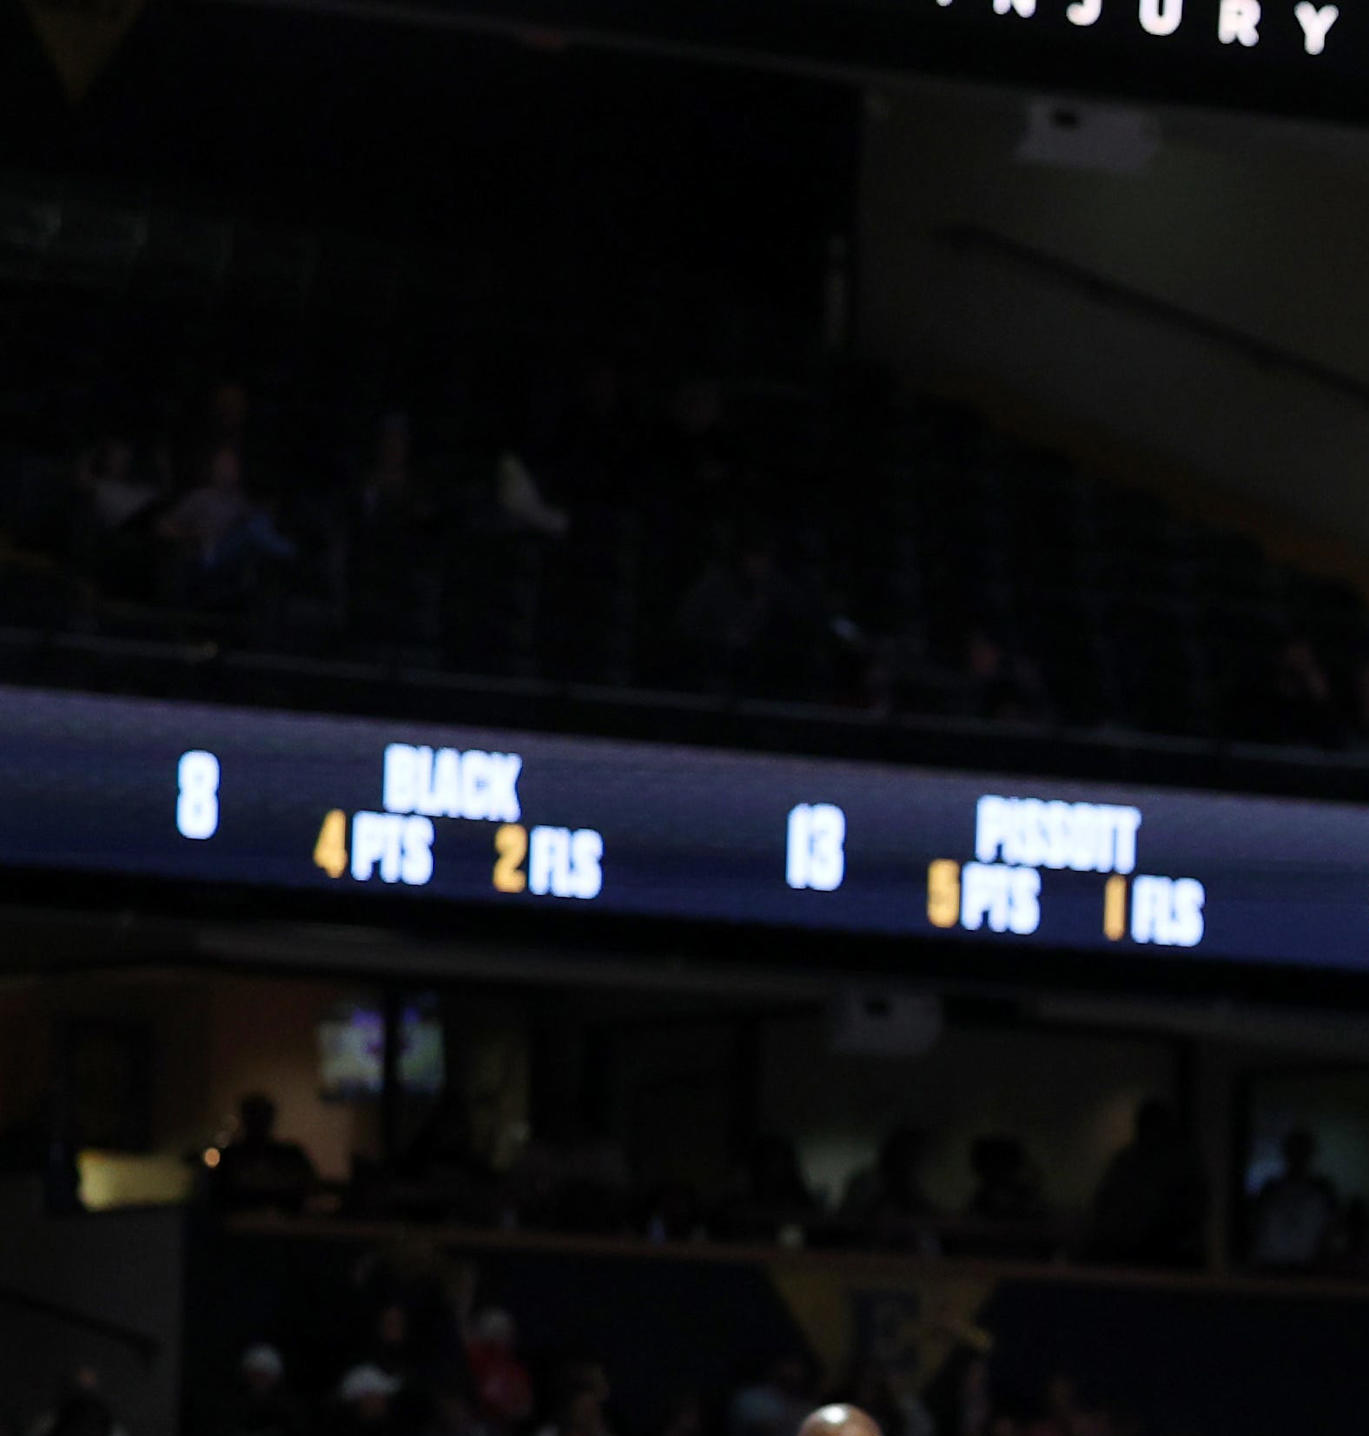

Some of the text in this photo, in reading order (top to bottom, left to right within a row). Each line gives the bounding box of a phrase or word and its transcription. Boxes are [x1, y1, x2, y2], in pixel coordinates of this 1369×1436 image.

[937, 0, 1338, 55] JURY
[176, 743, 522, 839] 8 BLACK
[313, 809, 347, 879] 4
[351, 810, 434, 885] PTS
[493, 824, 527, 893] 2
